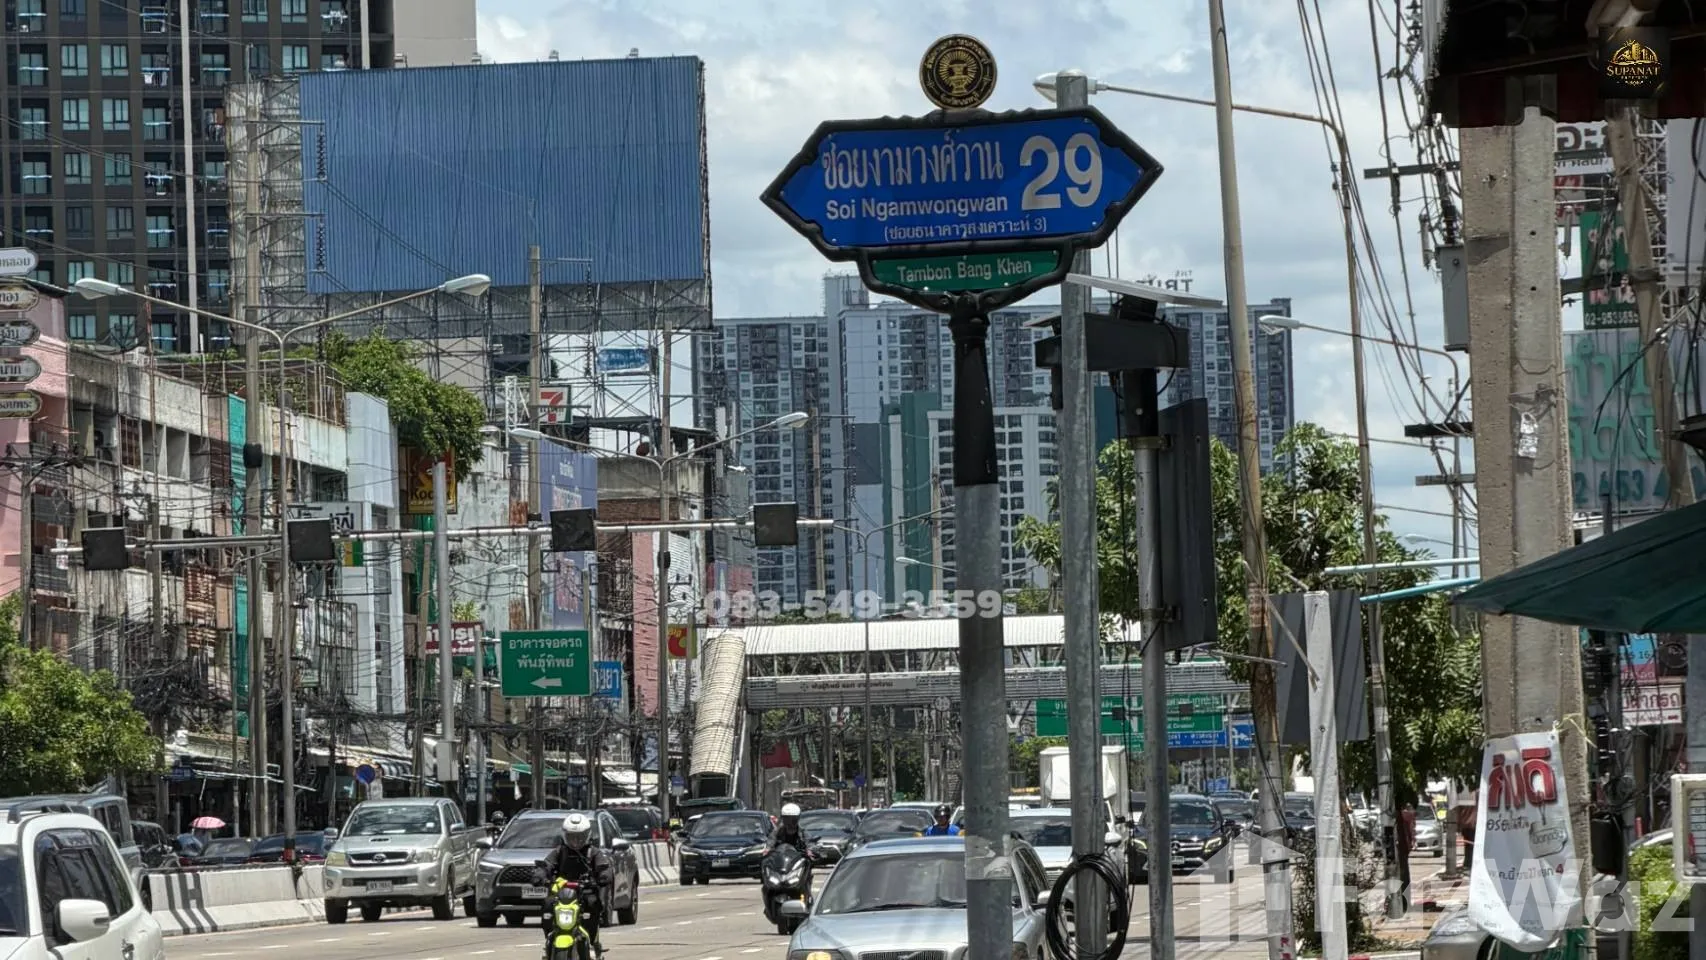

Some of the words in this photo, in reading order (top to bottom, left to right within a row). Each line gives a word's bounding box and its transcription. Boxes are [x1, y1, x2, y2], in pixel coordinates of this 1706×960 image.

[822, 130, 1004, 190] ซอยงามวงศ์วาน
[1019, 132, 1103, 210] 29
[826, 199, 856, 219] Soi
[861, 196, 1008, 221] Ngamwongwan
[1034, 217, 1047, 232] 3)
[897, 265, 951, 283] Tambon
[957, 261, 992, 280] Bang
[997, 258, 1032, 275] Khen
[508, 638, 583, 649] อาคารจอดรถ
[516, 653, 575, 673] พันธุ์ทิพย์
